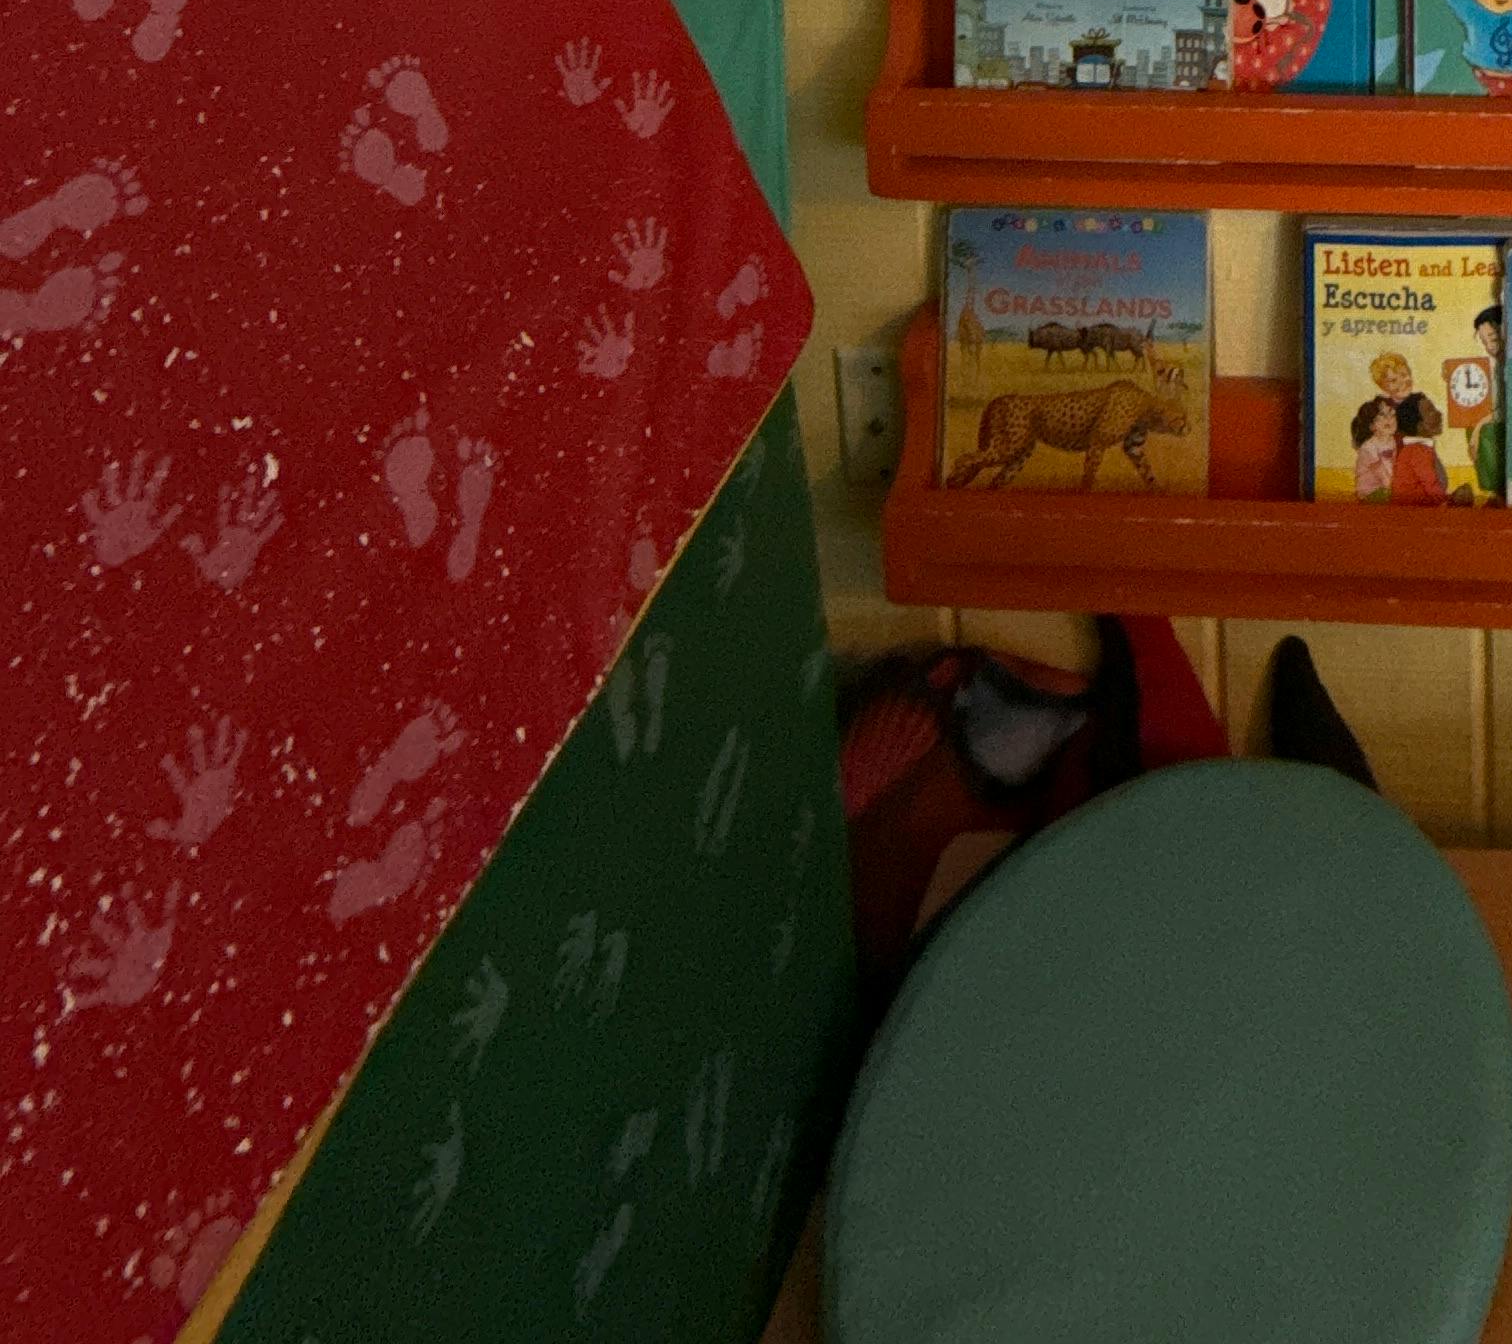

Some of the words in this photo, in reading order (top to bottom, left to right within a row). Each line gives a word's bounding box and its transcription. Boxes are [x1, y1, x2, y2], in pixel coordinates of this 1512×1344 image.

[1322, 250, 1410, 278] Listen
[1419, 259, 1451, 278] and
[984, 288, 1172, 319] GRASSLANDS
[1323, 284, 1436, 312] Escucha
[1323, 319, 1334, 337] y
[1340, 315, 1428, 336] aprende
